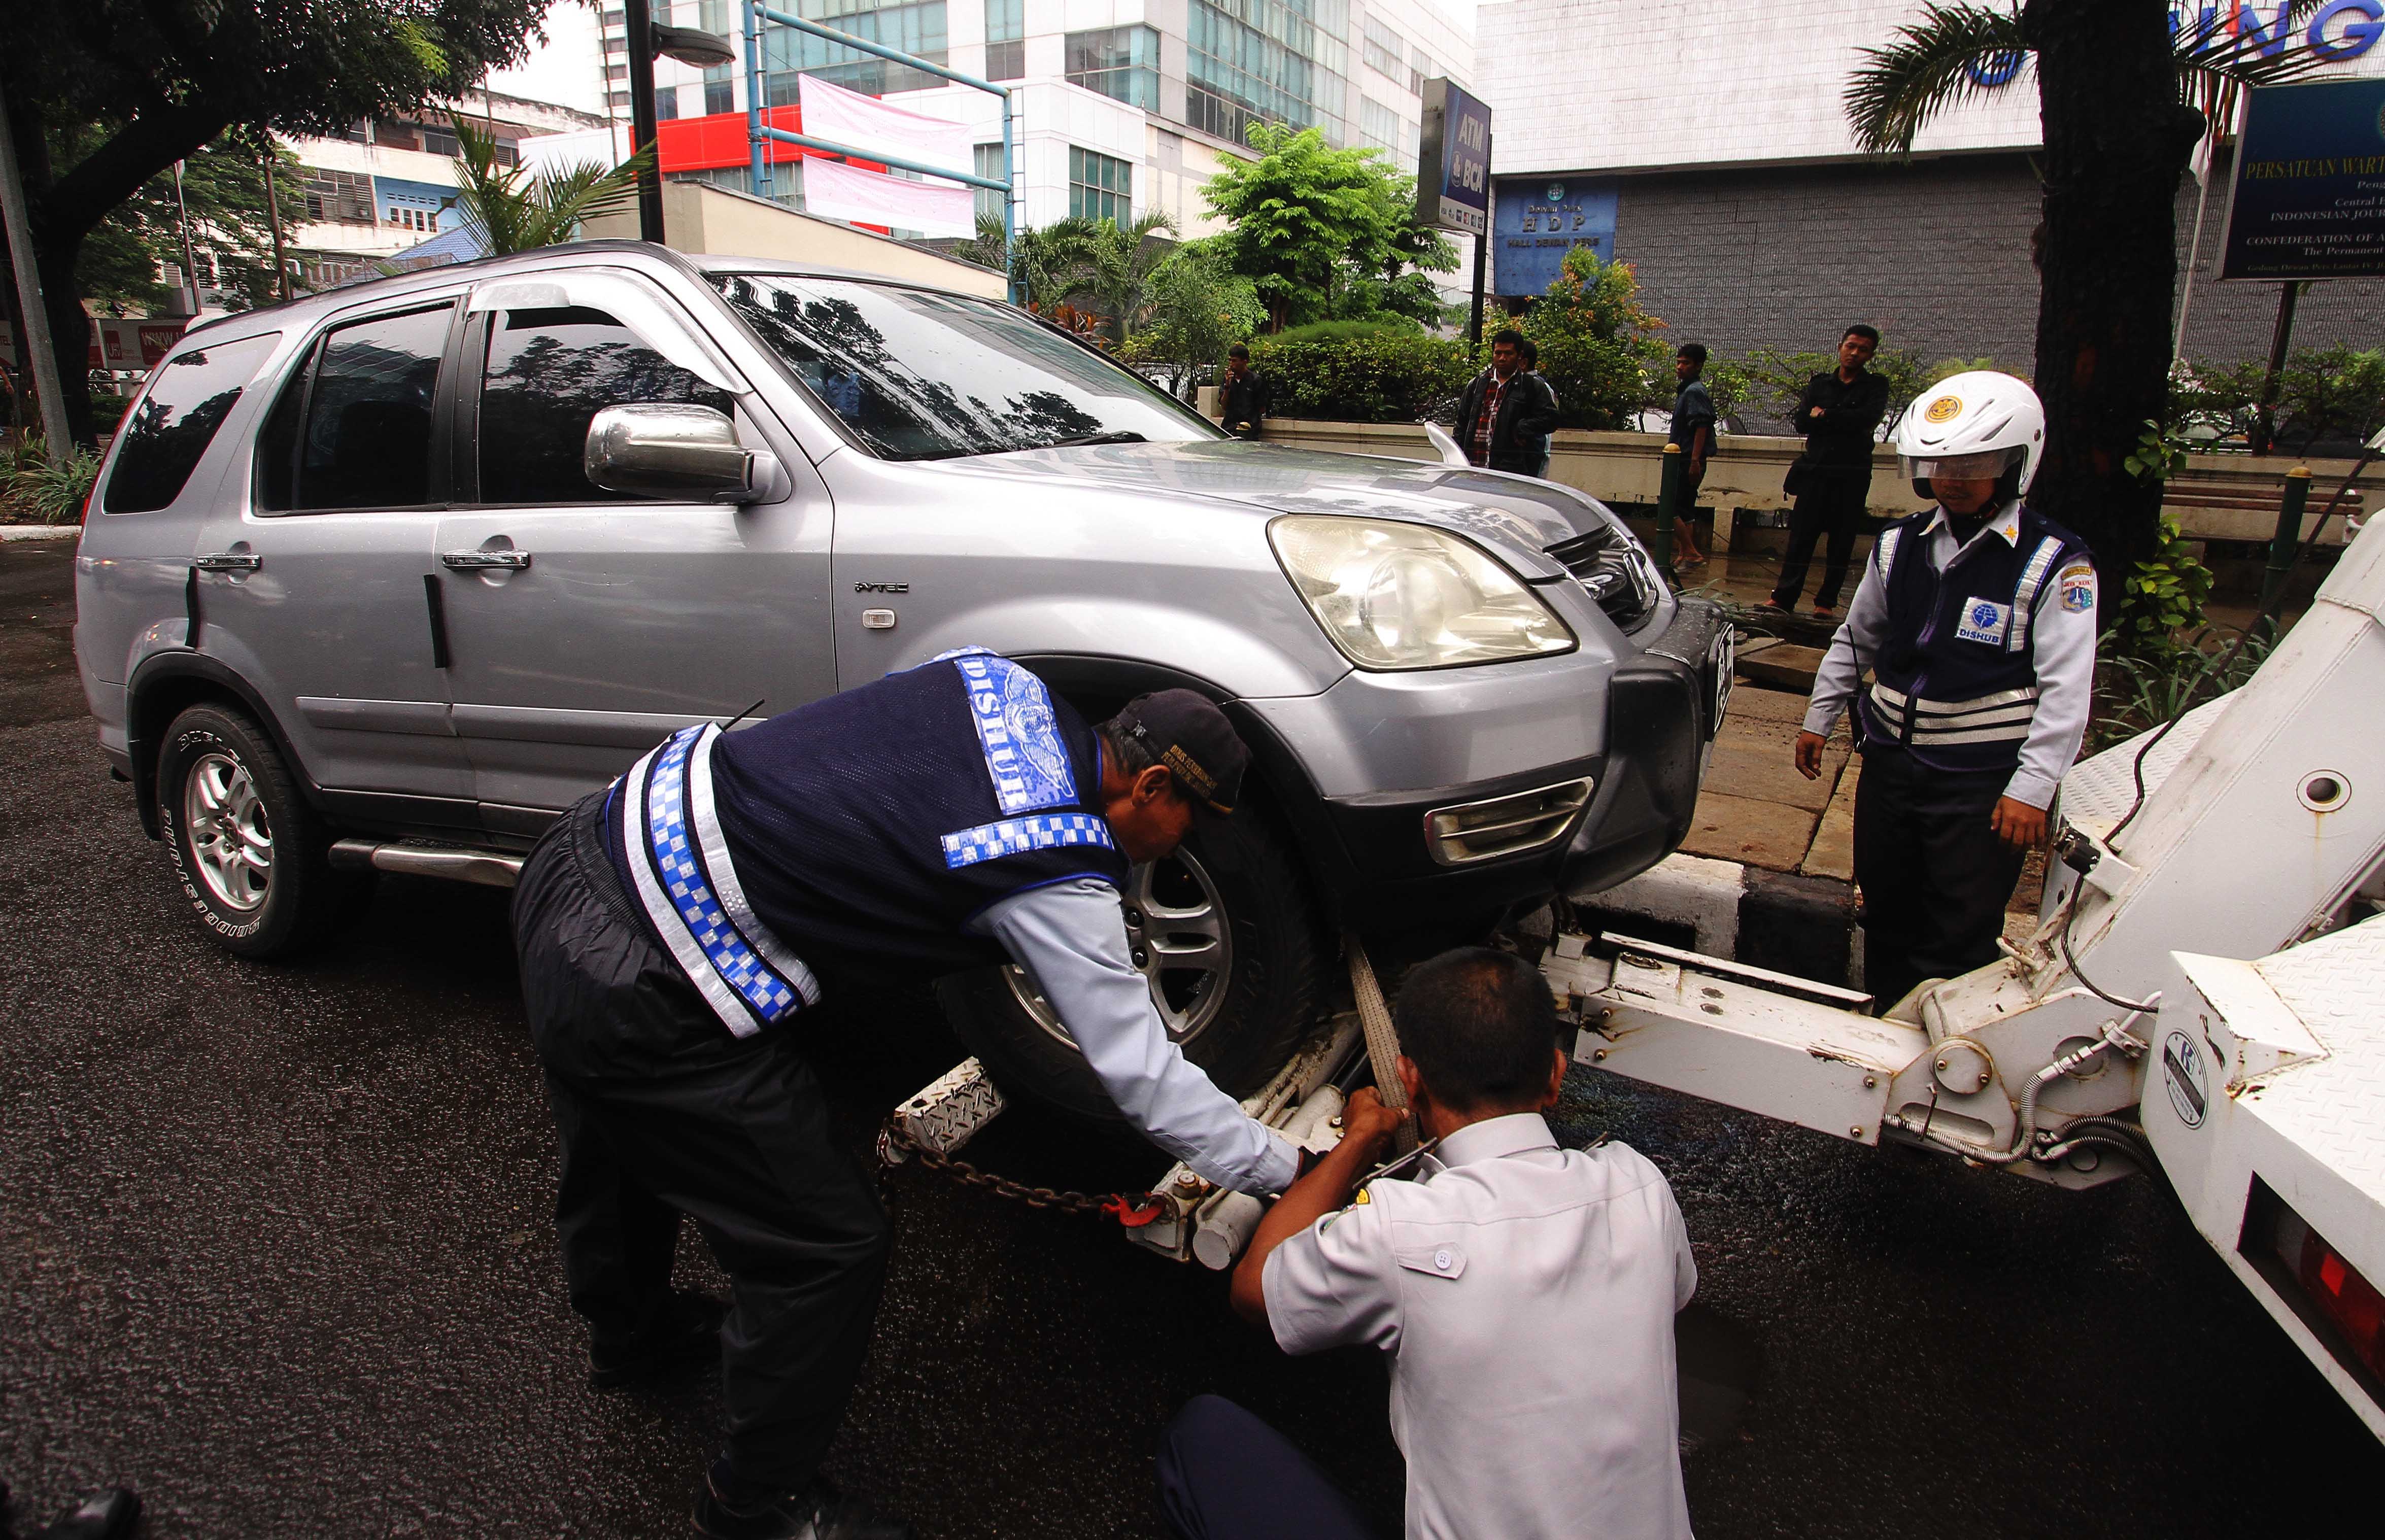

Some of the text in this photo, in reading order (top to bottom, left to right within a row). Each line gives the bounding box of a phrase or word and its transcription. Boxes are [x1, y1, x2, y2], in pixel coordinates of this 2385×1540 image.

[1458, 113, 1484, 152] ATM
[2245, 158, 2337, 179] PERSATUAN
[1462, 158, 1483, 194] BCA
[2335, 196, 2375, 207] Central
[2270, 210, 2349, 222] INDONESIAN
[1507, 239, 1531, 248] HALL
[1536, 238, 1570, 247] DEWAN
[2246, 234, 2352, 246] CONFEDERATION
[2356, 233, 2374, 243] OF
[2303, 246, 2384, 255] The Permanent
[1959, 629, 1999, 643] DISHUB
[961, 660, 1028, 807] DISHUB
